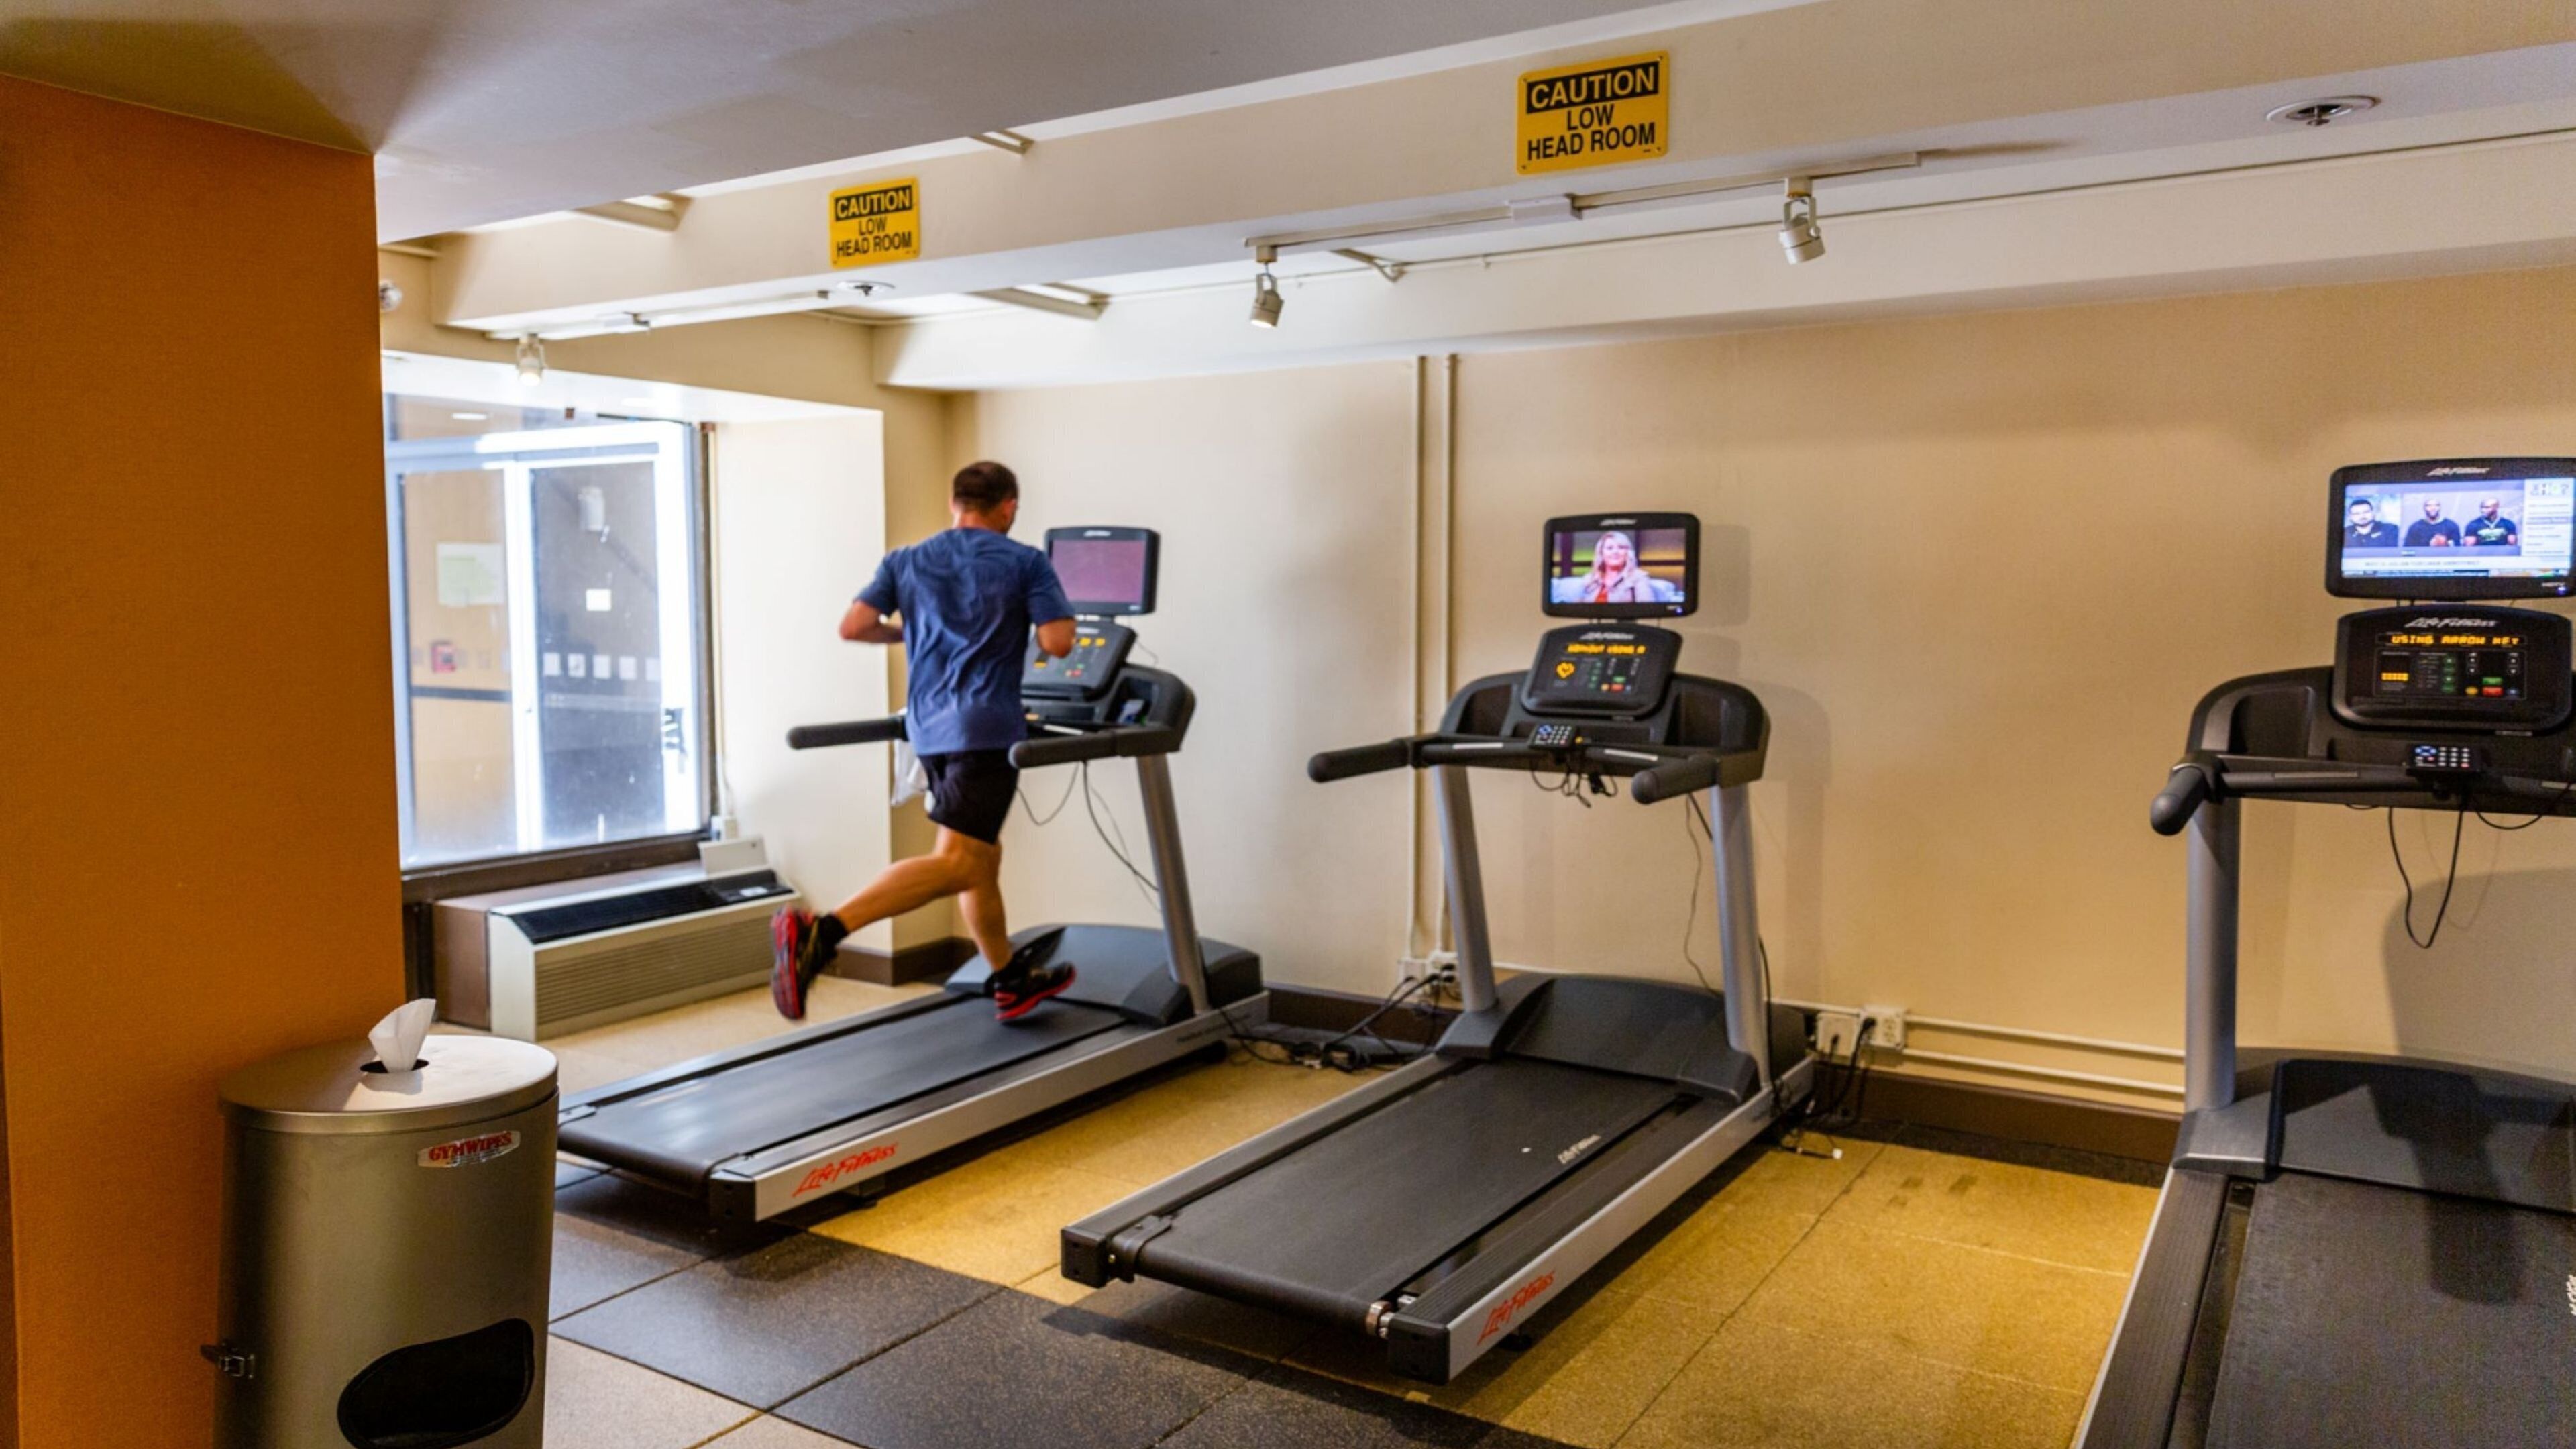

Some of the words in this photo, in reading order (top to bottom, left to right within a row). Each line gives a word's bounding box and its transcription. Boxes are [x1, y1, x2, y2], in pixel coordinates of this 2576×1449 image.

[1531, 66, 1654, 109] CAUTION
[1567, 103, 1615, 131] LOW
[1527, 132, 1584, 161] HEAD
[1591, 122, 1656, 152] ROOM
[837, 189, 910, 218] CAUTION
[859, 215, 887, 236] LOW
[837, 237, 870, 258] HEAD
[873, 231, 912, 252] ROOM
[2391, 634, 2434, 645] USING
[2440, 635, 2486, 645] ARROW
